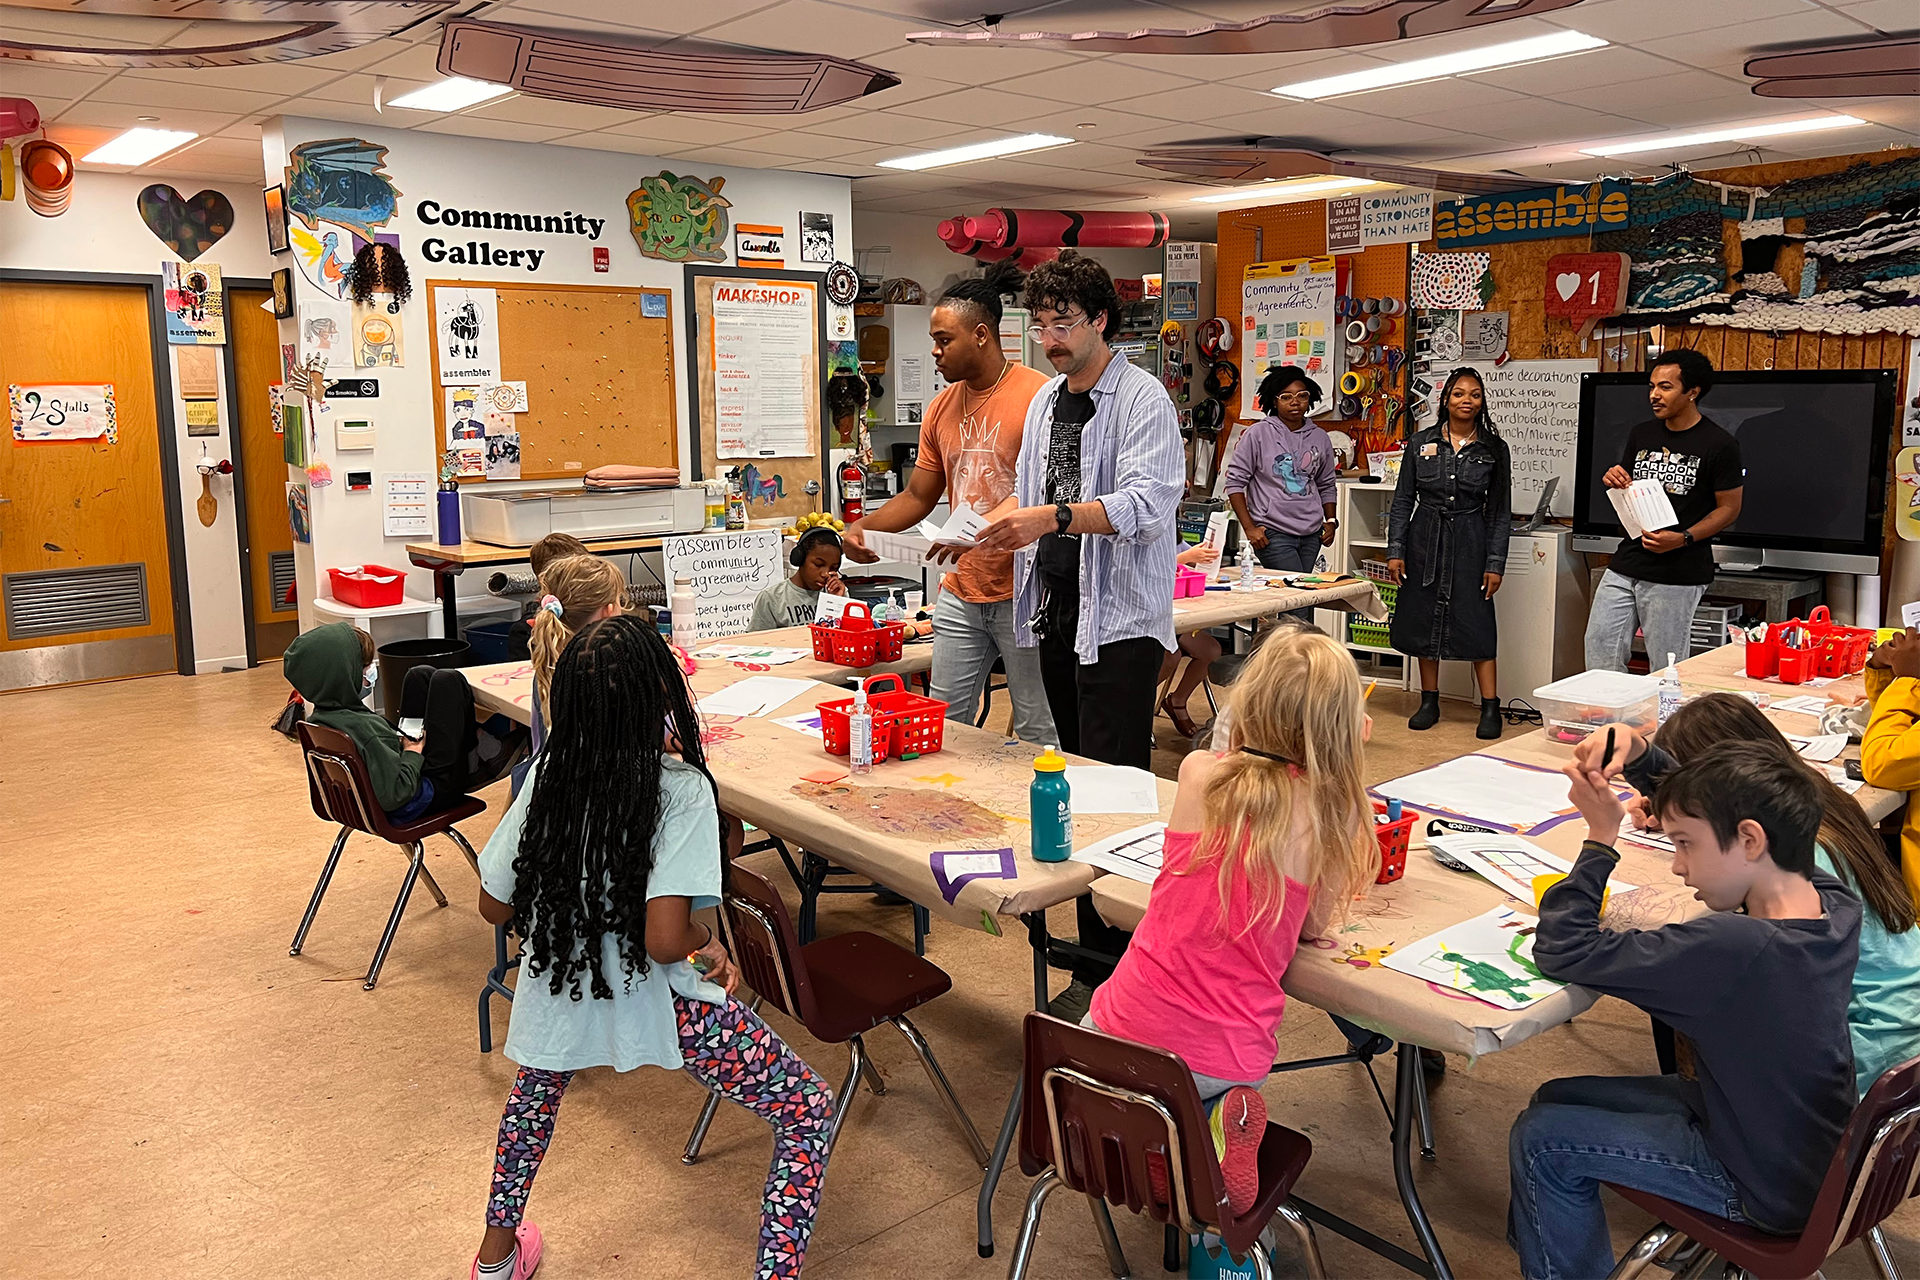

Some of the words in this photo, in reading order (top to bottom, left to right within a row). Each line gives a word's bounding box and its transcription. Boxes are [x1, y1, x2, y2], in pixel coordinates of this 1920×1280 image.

[1333, 201, 1343, 209] TO
[1344, 199, 1359, 207] LIVE
[1364, 192, 1430, 210] COMMUNITY
[1345, 207, 1356, 215] AN
[1364, 214, 1373, 224] IS
[1376, 207, 1430, 223] STRONGER
[1435, 186, 1629, 240] assemble
[416, 199, 606, 241] Community
[1335, 224, 1357, 232] WORLD
[1330, 232, 1341, 240] WE
[1364, 225, 1397, 238] THAN
[1402, 221, 1429, 234] HATE
[421, 238, 545, 271] Gallery
[1183, 252, 1199, 260] PEOPLE
[1244, 282, 1305, 304] Community
[1588, 270, 1600, 305] 1
[717, 288, 801, 305] MAKESHOP
[1257, 291, 1322, 317] Agreements!
[169, 328, 217, 338] assembler
[443, 368, 492, 378] assembler
[1518, 369, 1580, 385] decorations
[25, 391, 46, 421] 2
[1634, 461, 1698, 477] CARTOON
[1632, 470, 1697, 487] NETWORK
[675, 535, 766, 557] assemble's
[692, 556, 765, 578] community
[690, 571, 760, 593] agreements
